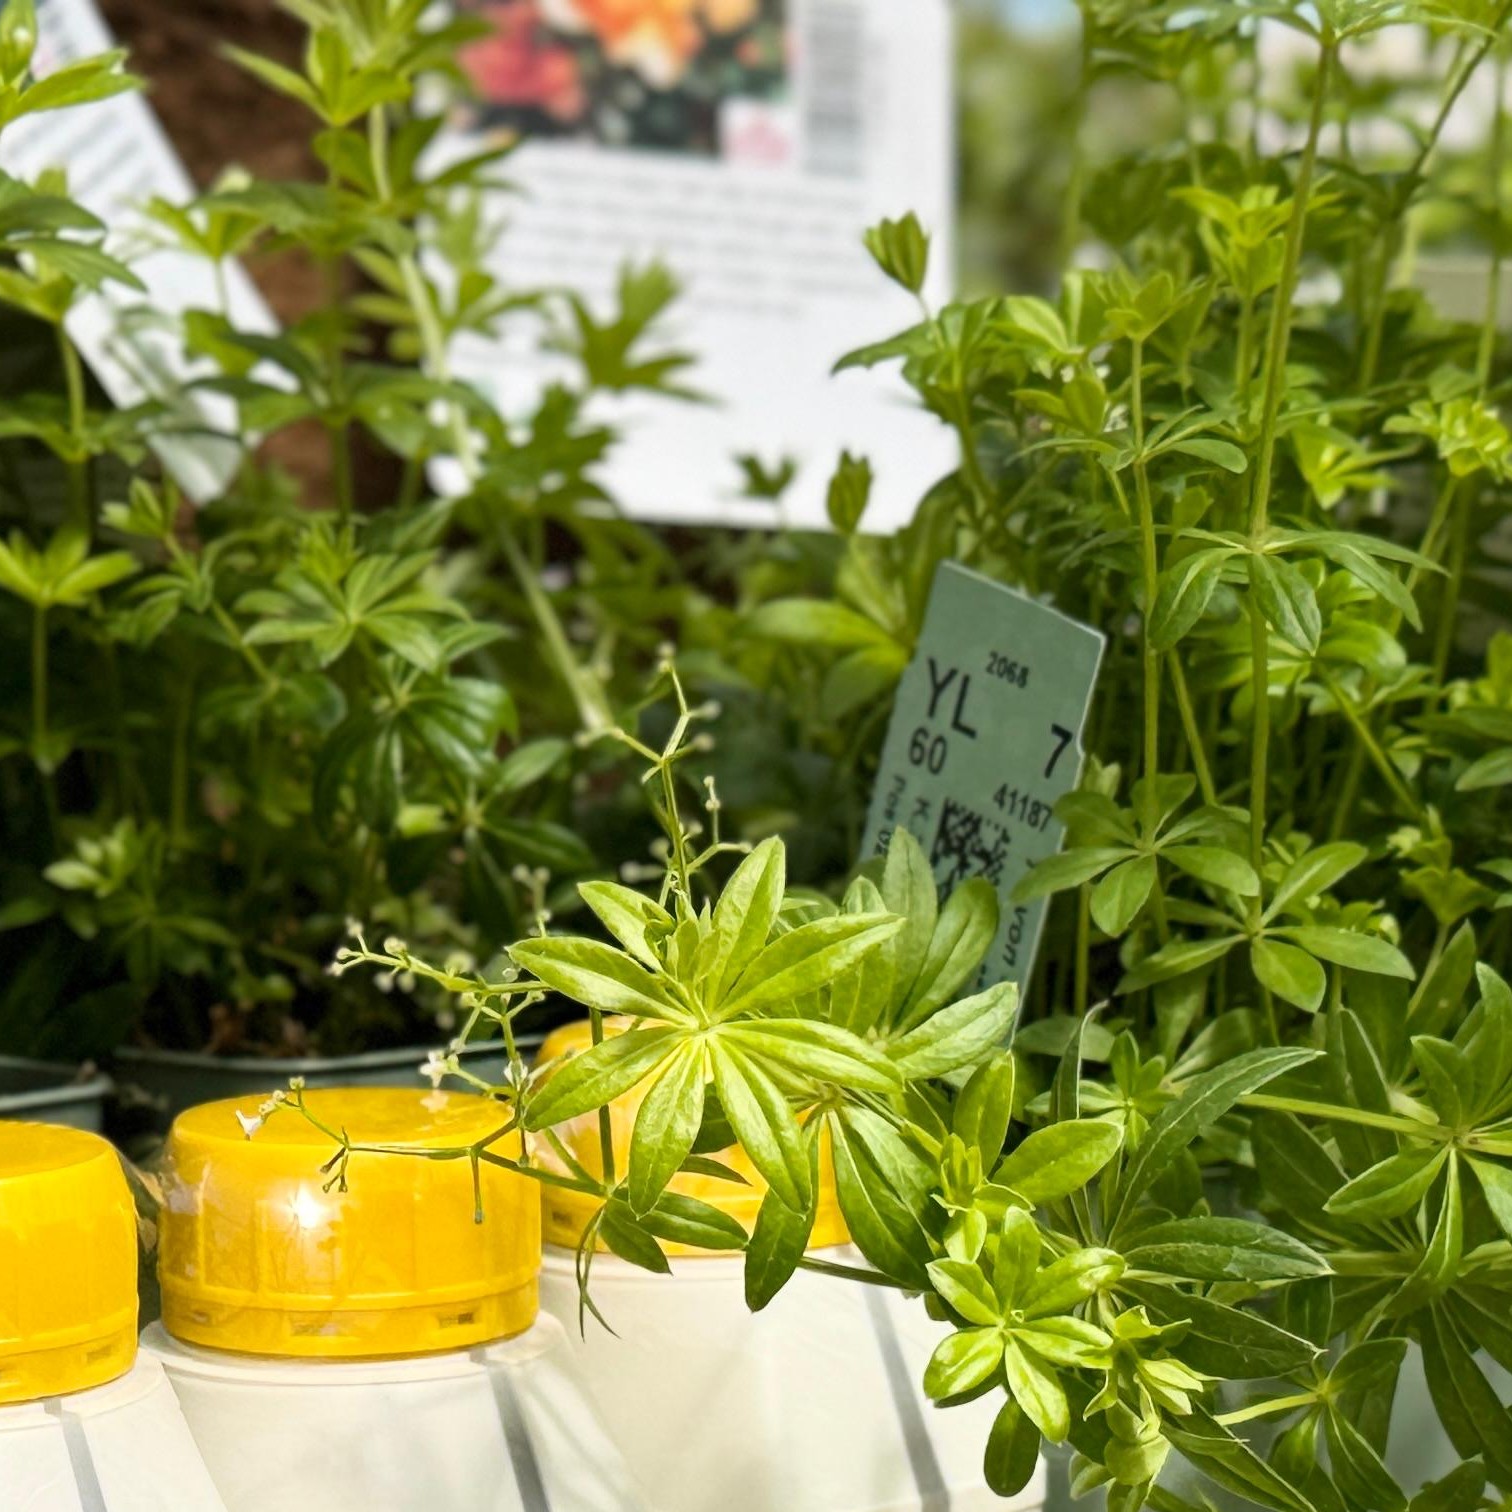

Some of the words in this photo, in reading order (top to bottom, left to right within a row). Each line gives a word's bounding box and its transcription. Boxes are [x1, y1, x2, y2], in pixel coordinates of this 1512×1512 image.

[986, 651, 1030, 689] 2068
[927, 656, 978, 740] YL
[908, 726, 948, 775] 60
[1044, 722, 1074, 779] 7
[993, 782, 1053, 832] 41187
[1003, 905, 1028, 969] von
